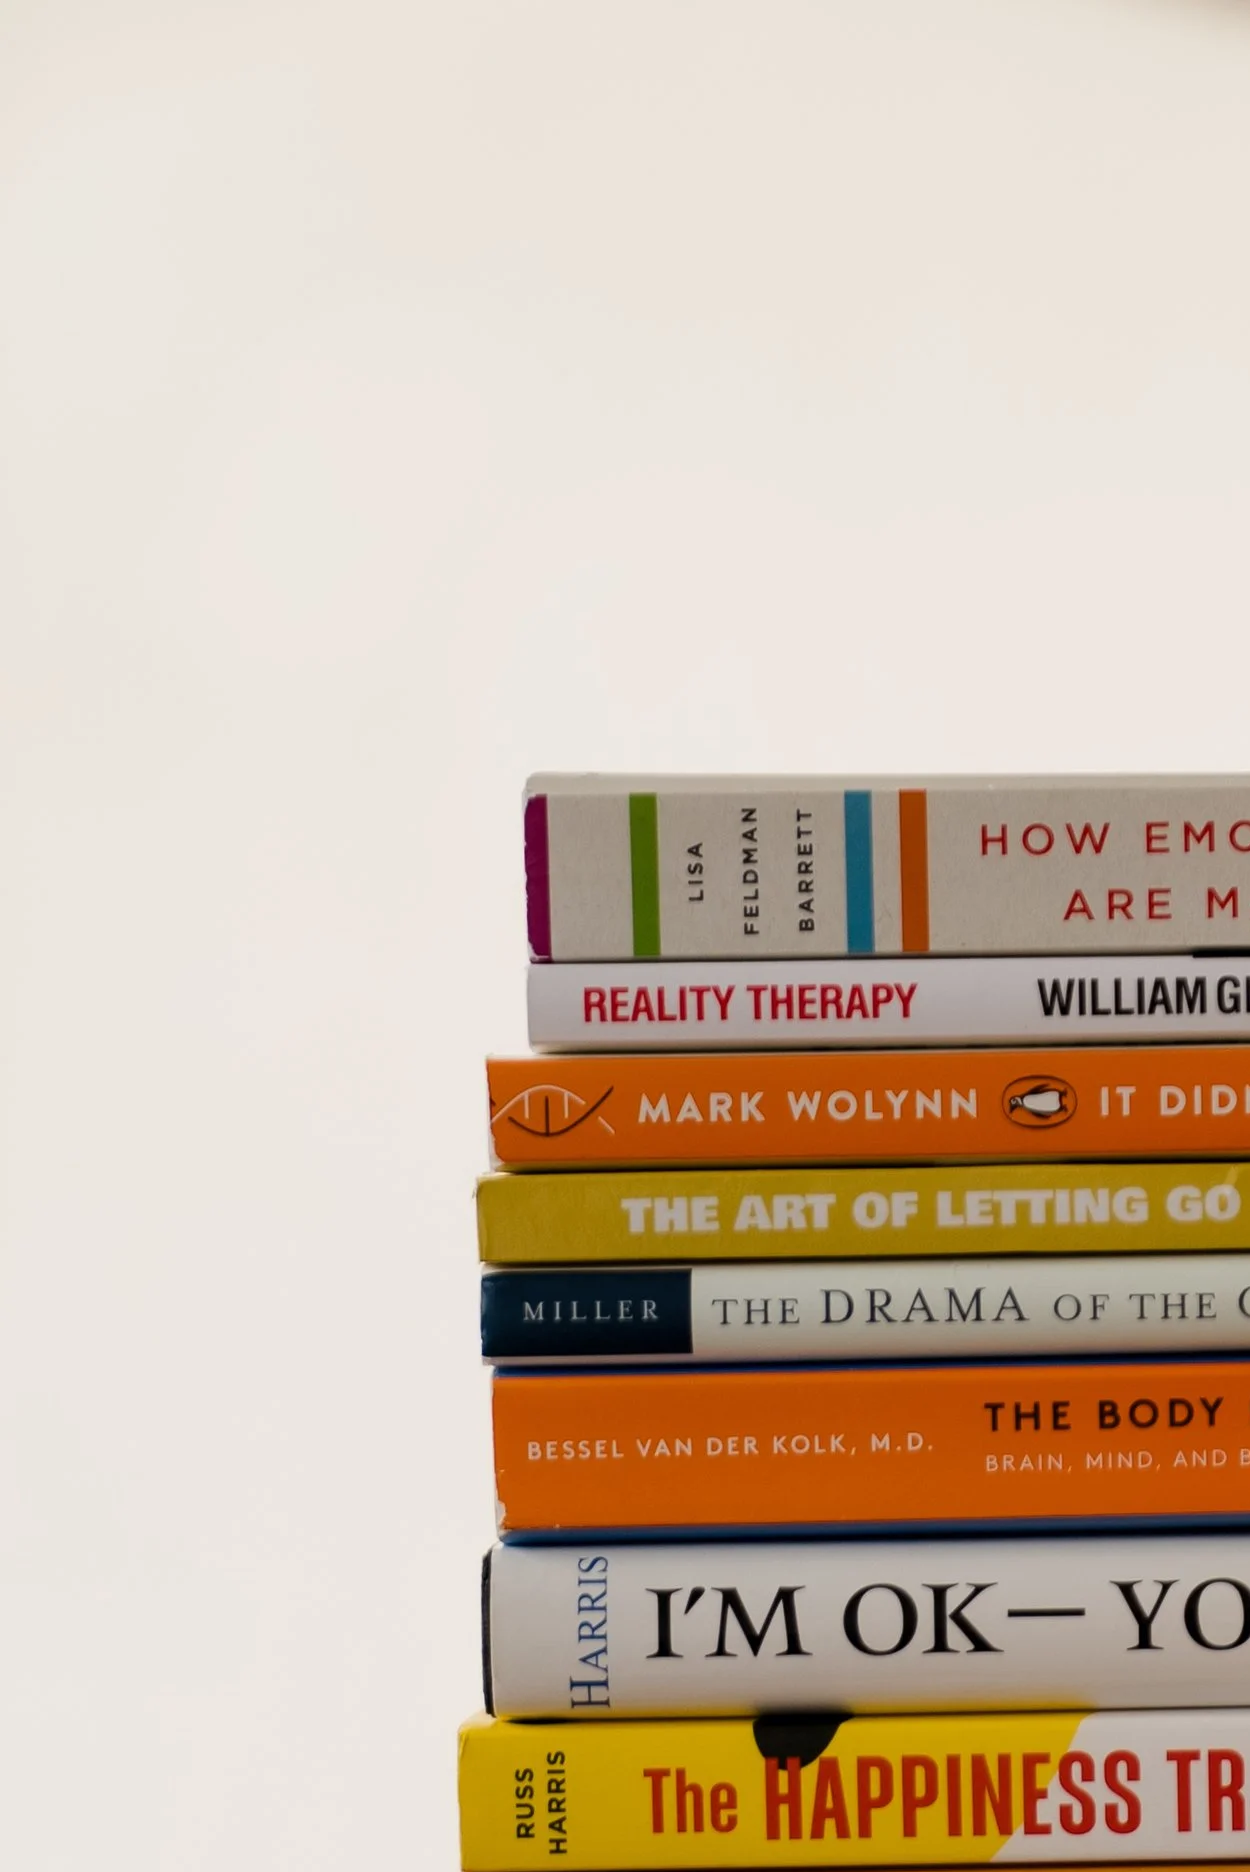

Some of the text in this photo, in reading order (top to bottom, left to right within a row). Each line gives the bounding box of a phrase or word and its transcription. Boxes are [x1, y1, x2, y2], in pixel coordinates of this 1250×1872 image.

[980, 822, 1111, 856] HOW
[687, 842, 704, 901] LISA
[742, 807, 757, 935] FELDMAN
[798, 808, 813, 932] BARRETT
[1062, 888, 1174, 921] ARE
[583, 981, 918, 1023] REALITY THERAPY
[1037, 975, 1208, 1017] WILLIAM
[637, 1088, 979, 1125] MARK WOLYNN
[1100, 1085, 1136, 1117] IT
[621, 1184, 1242, 1234] THE ART OF LETTING GO
[523, 1298, 659, 1323] MILLER
[711, 1297, 801, 1326] THE
[819, 1286, 1029, 1326] DRAMA
[1053, 1293, 1110, 1322] OF
[1128, 1291, 1217, 1319] THE
[983, 1401, 1072, 1433] THE
[1098, 1397, 1224, 1430] BODY
[528, 1431, 934, 1461] BESSEL VAN DER KOLK, M.D.
[985, 1452, 1073, 1474] BRAIN,
[1085, 1450, 1162, 1472] MIND,
[1173, 1447, 1227, 1468] AND
[569, 1555, 611, 1709] HARRIS
[515, 1767, 536, 1839] RUSS
[548, 1750, 568, 1855] HARRIS
[643, 1767, 739, 1834] The
[765, 1749, 1142, 1840] HAPPINESS
